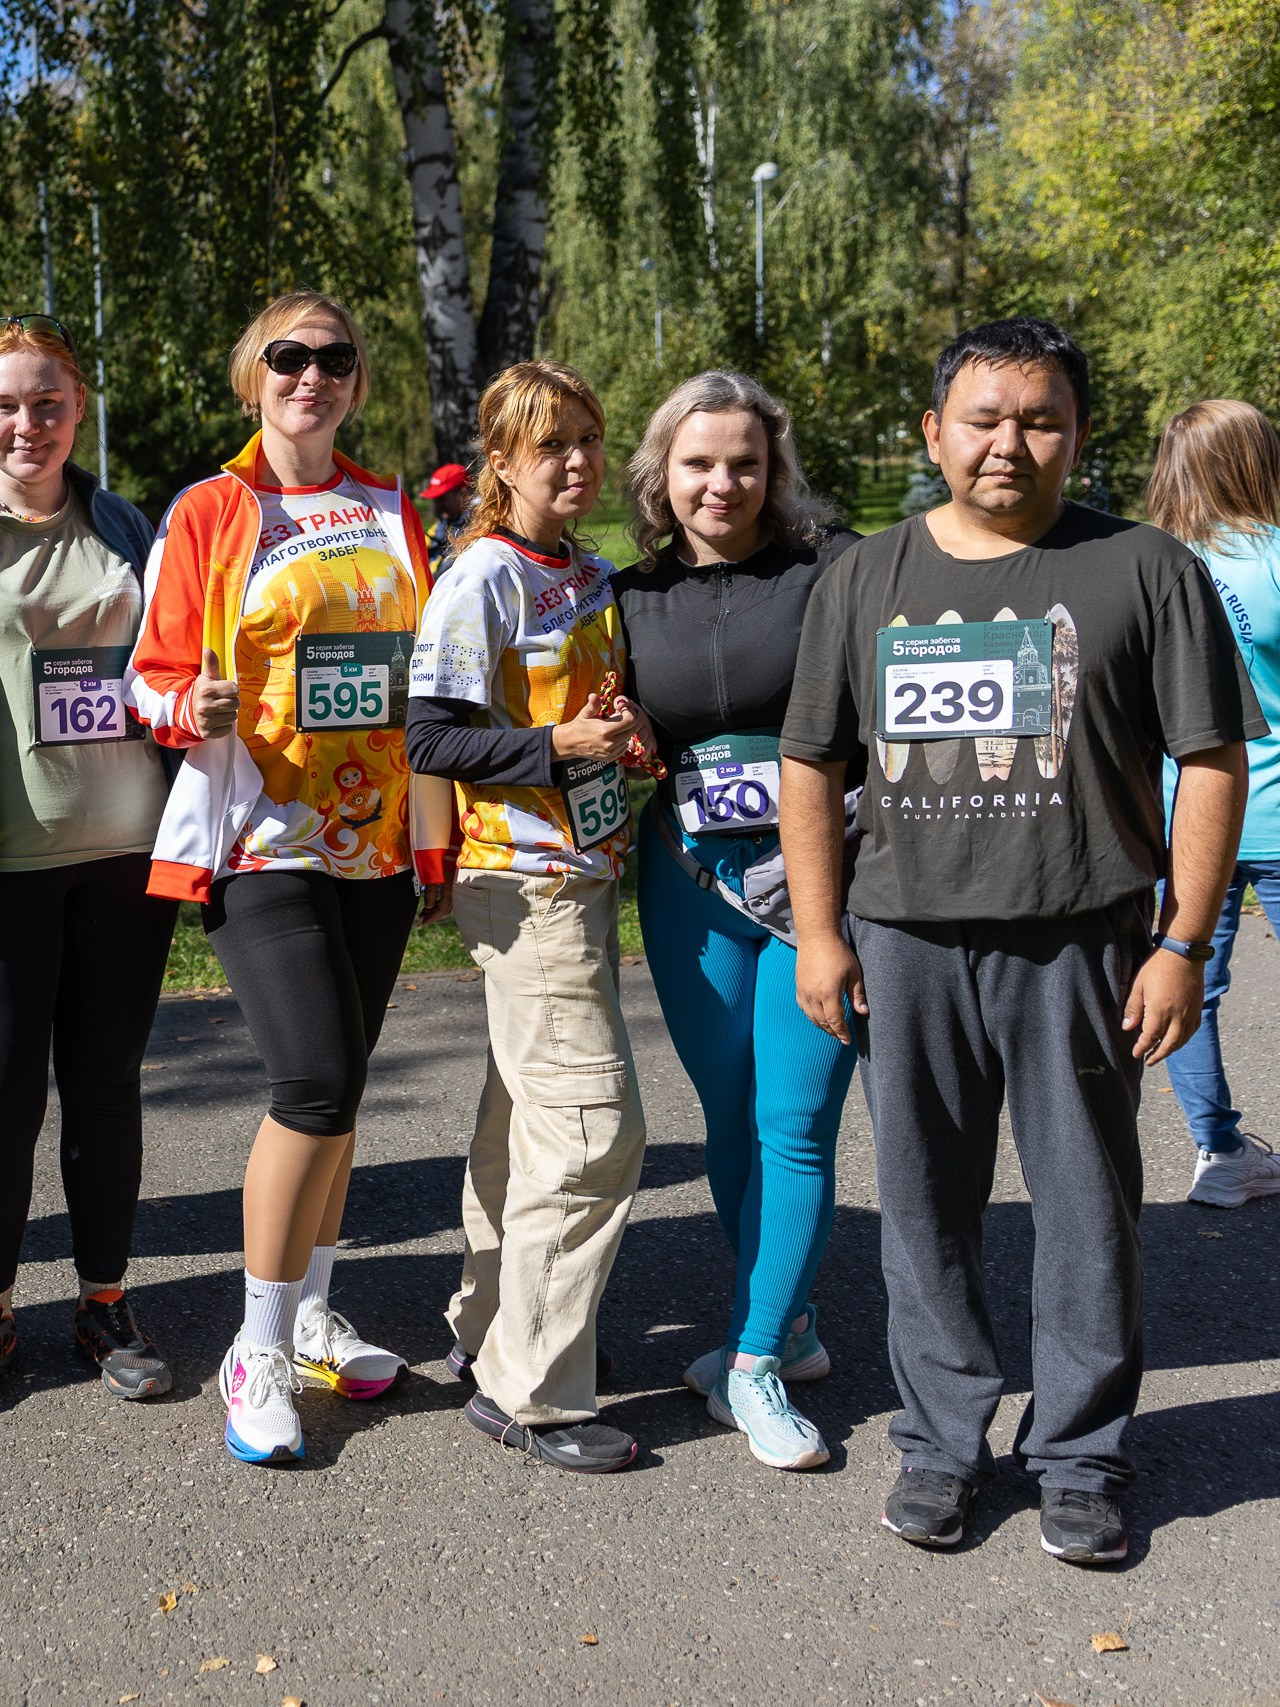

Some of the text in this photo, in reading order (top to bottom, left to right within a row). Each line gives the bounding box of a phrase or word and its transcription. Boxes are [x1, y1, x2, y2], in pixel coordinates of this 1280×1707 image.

[258, 506, 377, 549] ЕЗ ГРАНИ
[319, 543, 359, 562] ЗАБЕГ
[1226, 594, 1253, 644] RUSSIA
[892, 640, 961, 657] 5 городов
[905, 636, 961, 647] серия забегов
[306, 646, 355, 661] 5 городов
[43, 661, 93, 676] 5 городов
[308, 681, 383, 721] 595
[893, 679, 1004, 725] 239
[50, 695, 117, 734] 162
[706, 743, 730, 752] забегов
[681, 750, 732, 765] 5 городов
[567, 766, 577, 780] 5
[578, 778, 628, 837] 599
[687, 780, 770, 825] 150
[880, 792, 1063, 809] CALIFORNIA
[954, 810, 1037, 820] PARADISE
